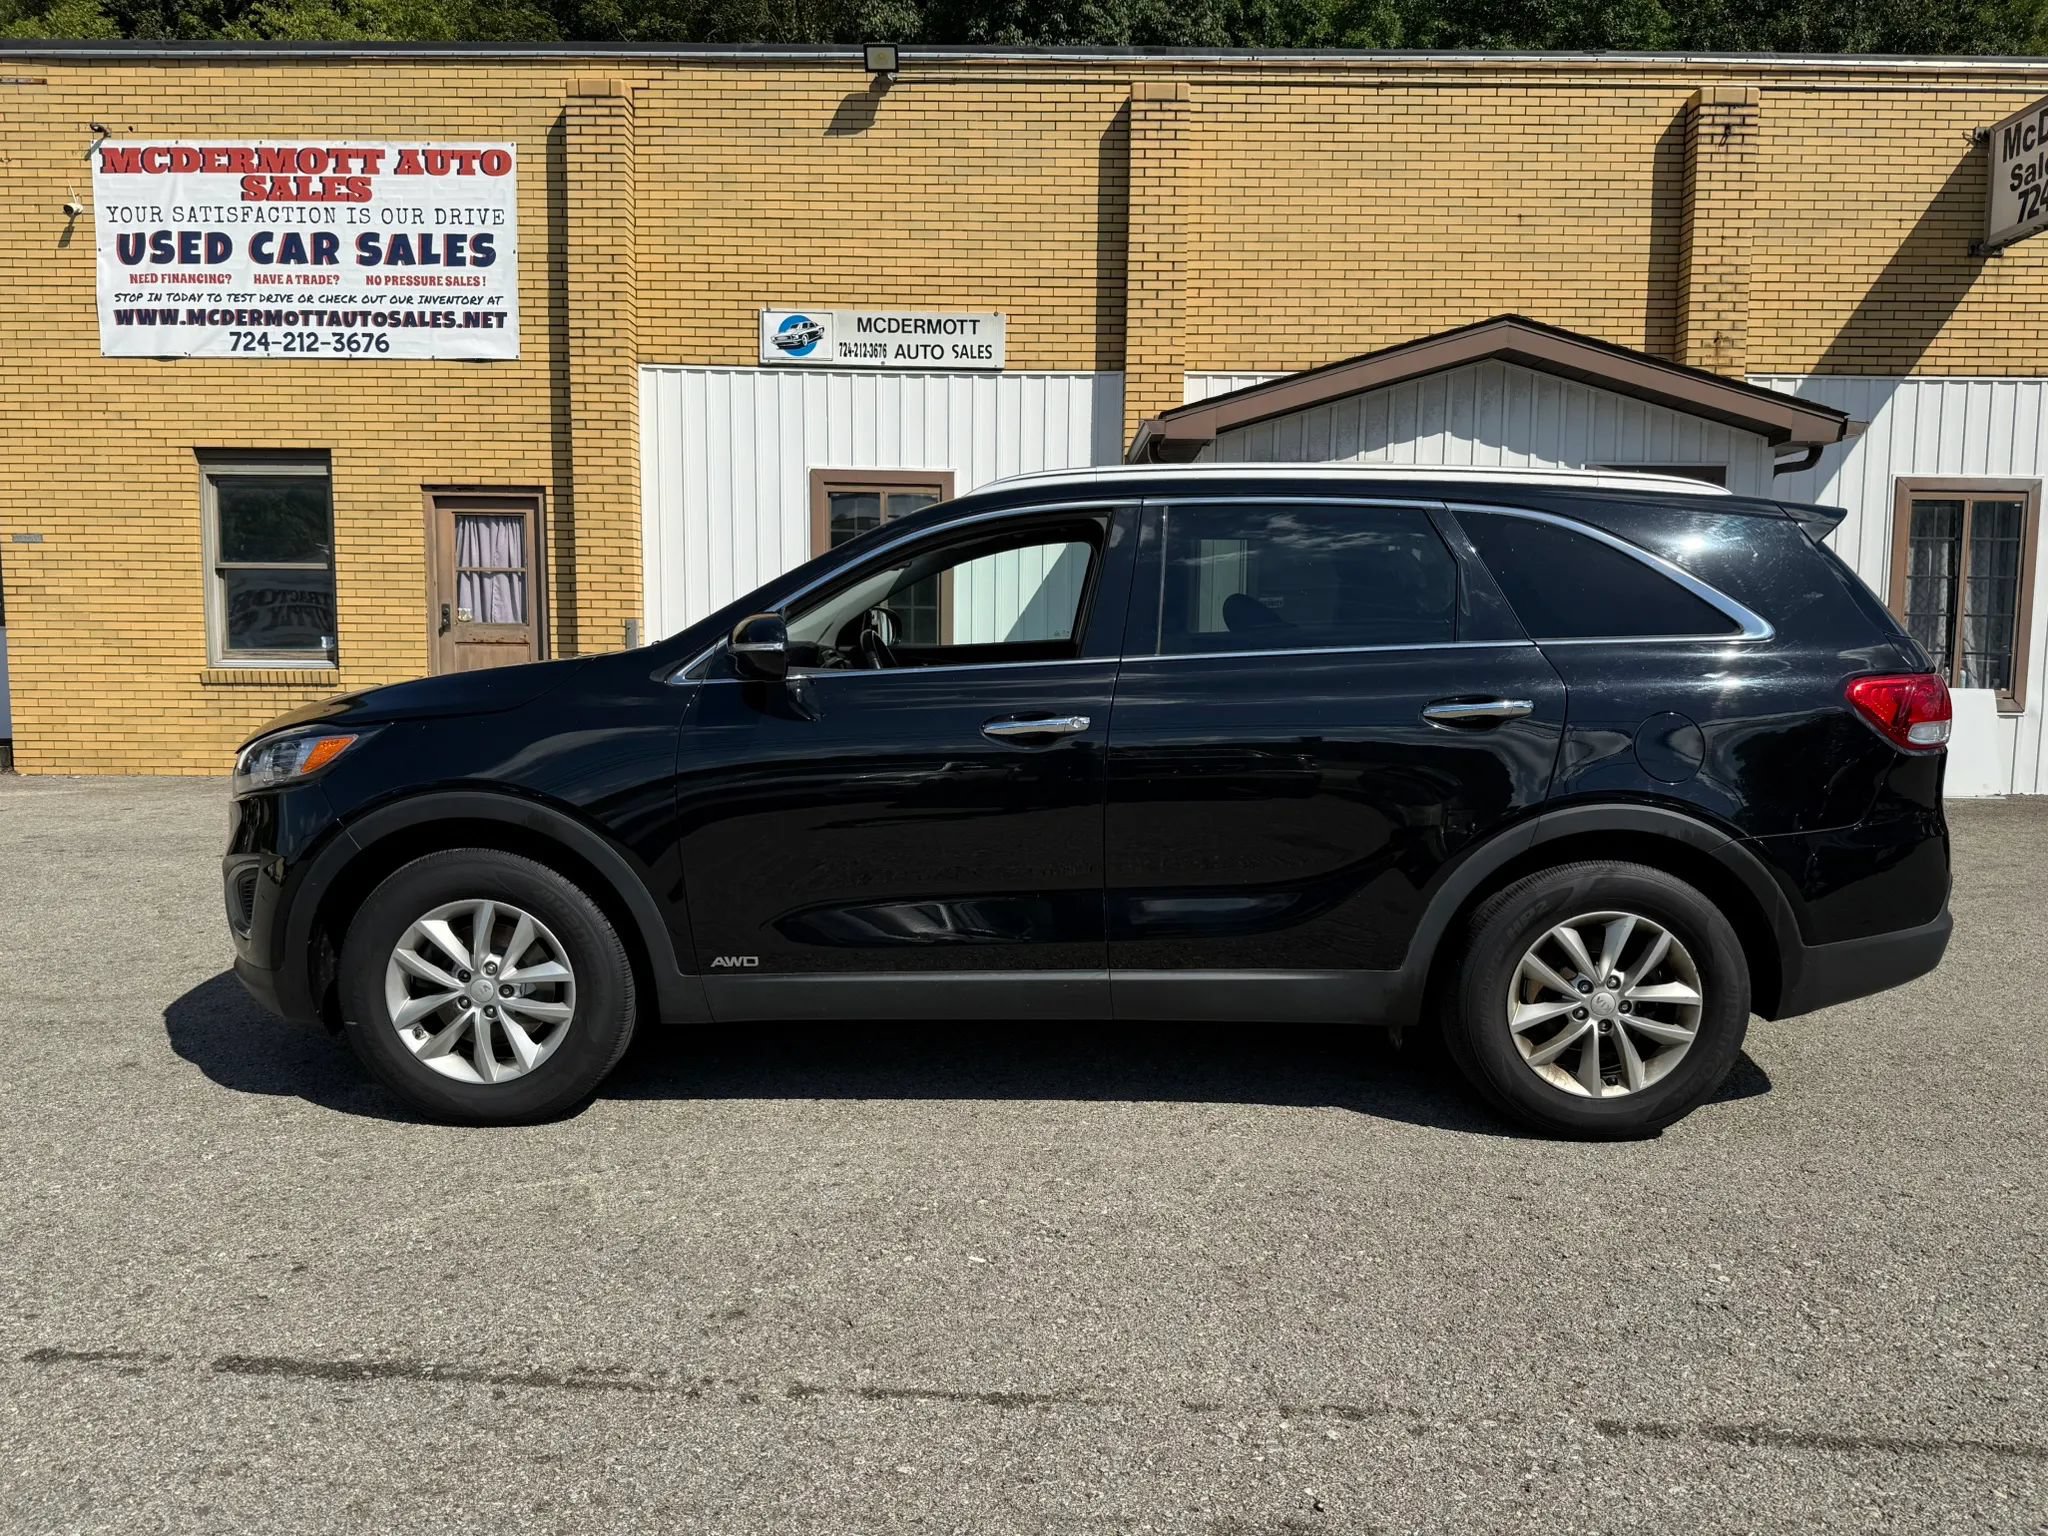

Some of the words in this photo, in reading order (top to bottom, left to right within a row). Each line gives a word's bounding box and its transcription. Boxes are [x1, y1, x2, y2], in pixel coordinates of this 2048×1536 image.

[98, 147, 385, 175] MCDERMOTT
[394, 149, 512, 176] AUTO
[2010, 152, 2048, 192] Sal
[240, 175, 373, 203] SALES
[106, 206, 164, 224] YOUR
[172, 206, 336, 225] SATISFACTION
[346, 207, 371, 225] IS
[381, 207, 425, 225] OUR
[435, 208, 505, 225] DRIVE
[116, 230, 233, 266] USED
[248, 231, 341, 266] CAR
[355, 232, 497, 268] SALES
[129, 273, 158, 285] NEED
[161, 273, 232, 285] FINANCING?
[253, 274, 284, 285] HAVE
[285, 275, 294, 285] A
[296, 275, 340, 286] TRADE?
[366, 276, 381, 287] NO
[384, 276, 443, 287] PRESSURE
[114, 293, 144, 303] STOP
[148, 293, 162, 303] IN
[166, 293, 204, 303] TODAY
[206, 293, 223, 303] TO
[226, 293, 258, 303] TEST
[259, 293, 294, 304] DRIVE
[297, 294, 315, 304] OR
[318, 294, 358, 305] CHECK
[361, 295, 387, 305] OUT
[389, 295, 415, 305] OUR
[417, 295, 484, 305] INVENTORY
[487, 295, 505, 305] AT
[113, 308, 507, 328] WWW.MCDERMOTTAUTOSALES.NET
[856, 317, 981, 335] MCDERMOTT
[229, 331, 390, 353] 724-212-3676
[838, 341, 888, 359] 724-212-3676
[894, 344, 945, 360] AUTO
[951, 344, 993, 360] SALES
[710, 956, 760, 968] AWD
